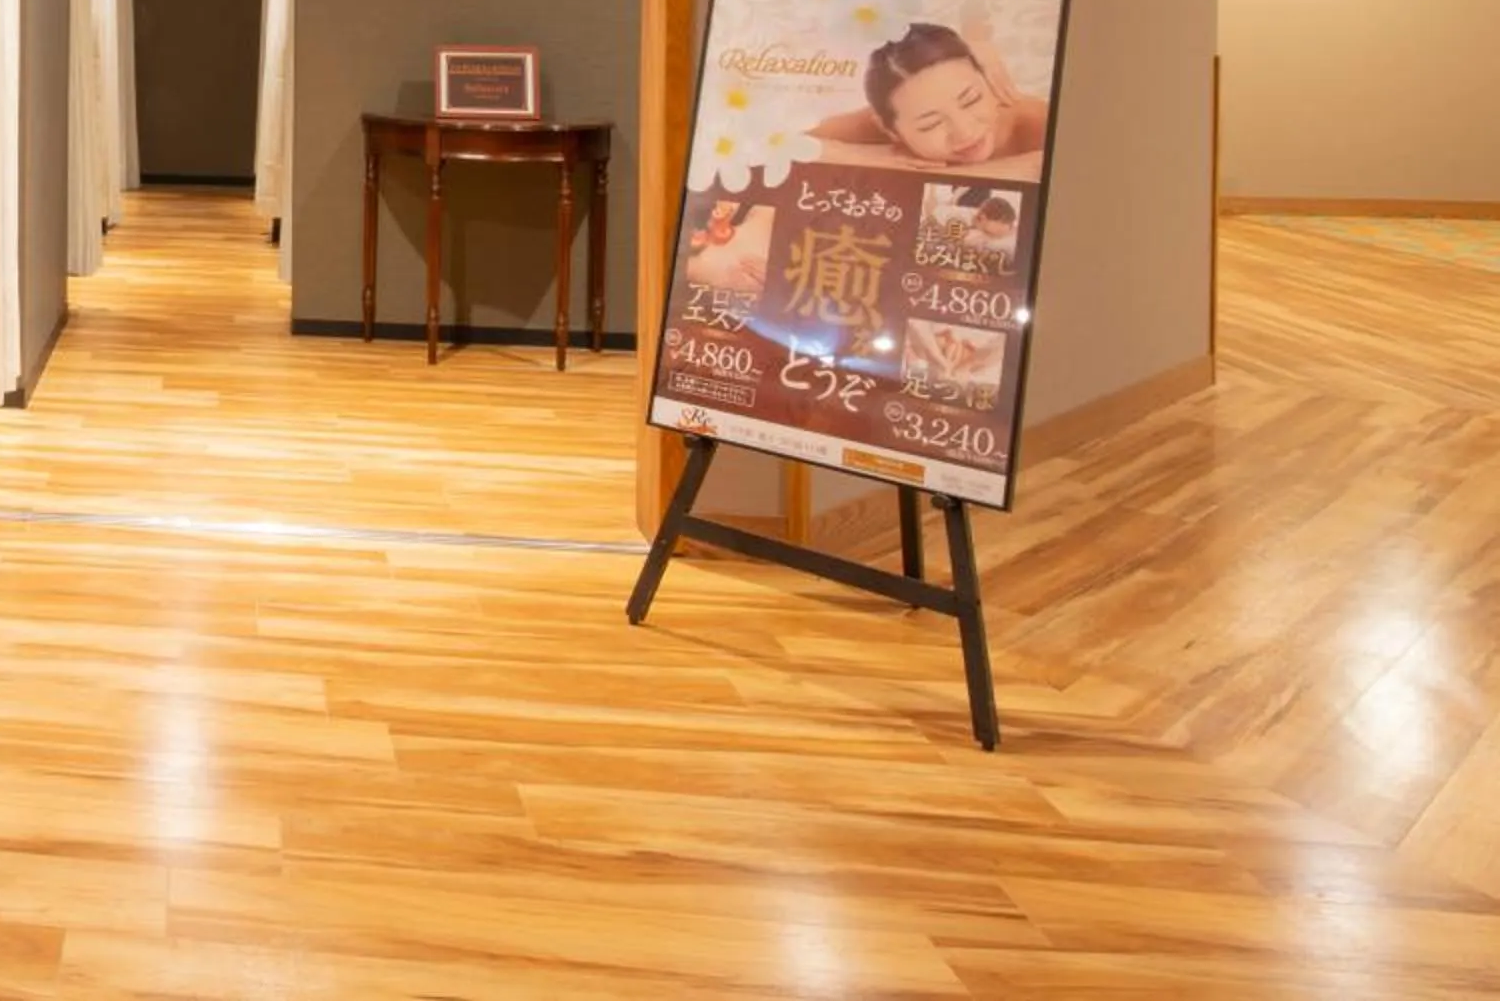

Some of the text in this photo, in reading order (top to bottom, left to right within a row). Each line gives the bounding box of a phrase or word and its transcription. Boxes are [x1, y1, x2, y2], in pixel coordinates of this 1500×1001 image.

[719, 43, 858, 80] Relaxation
[797, 181, 903, 222] とっておきの
[784, 225, 892, 331] 癒
